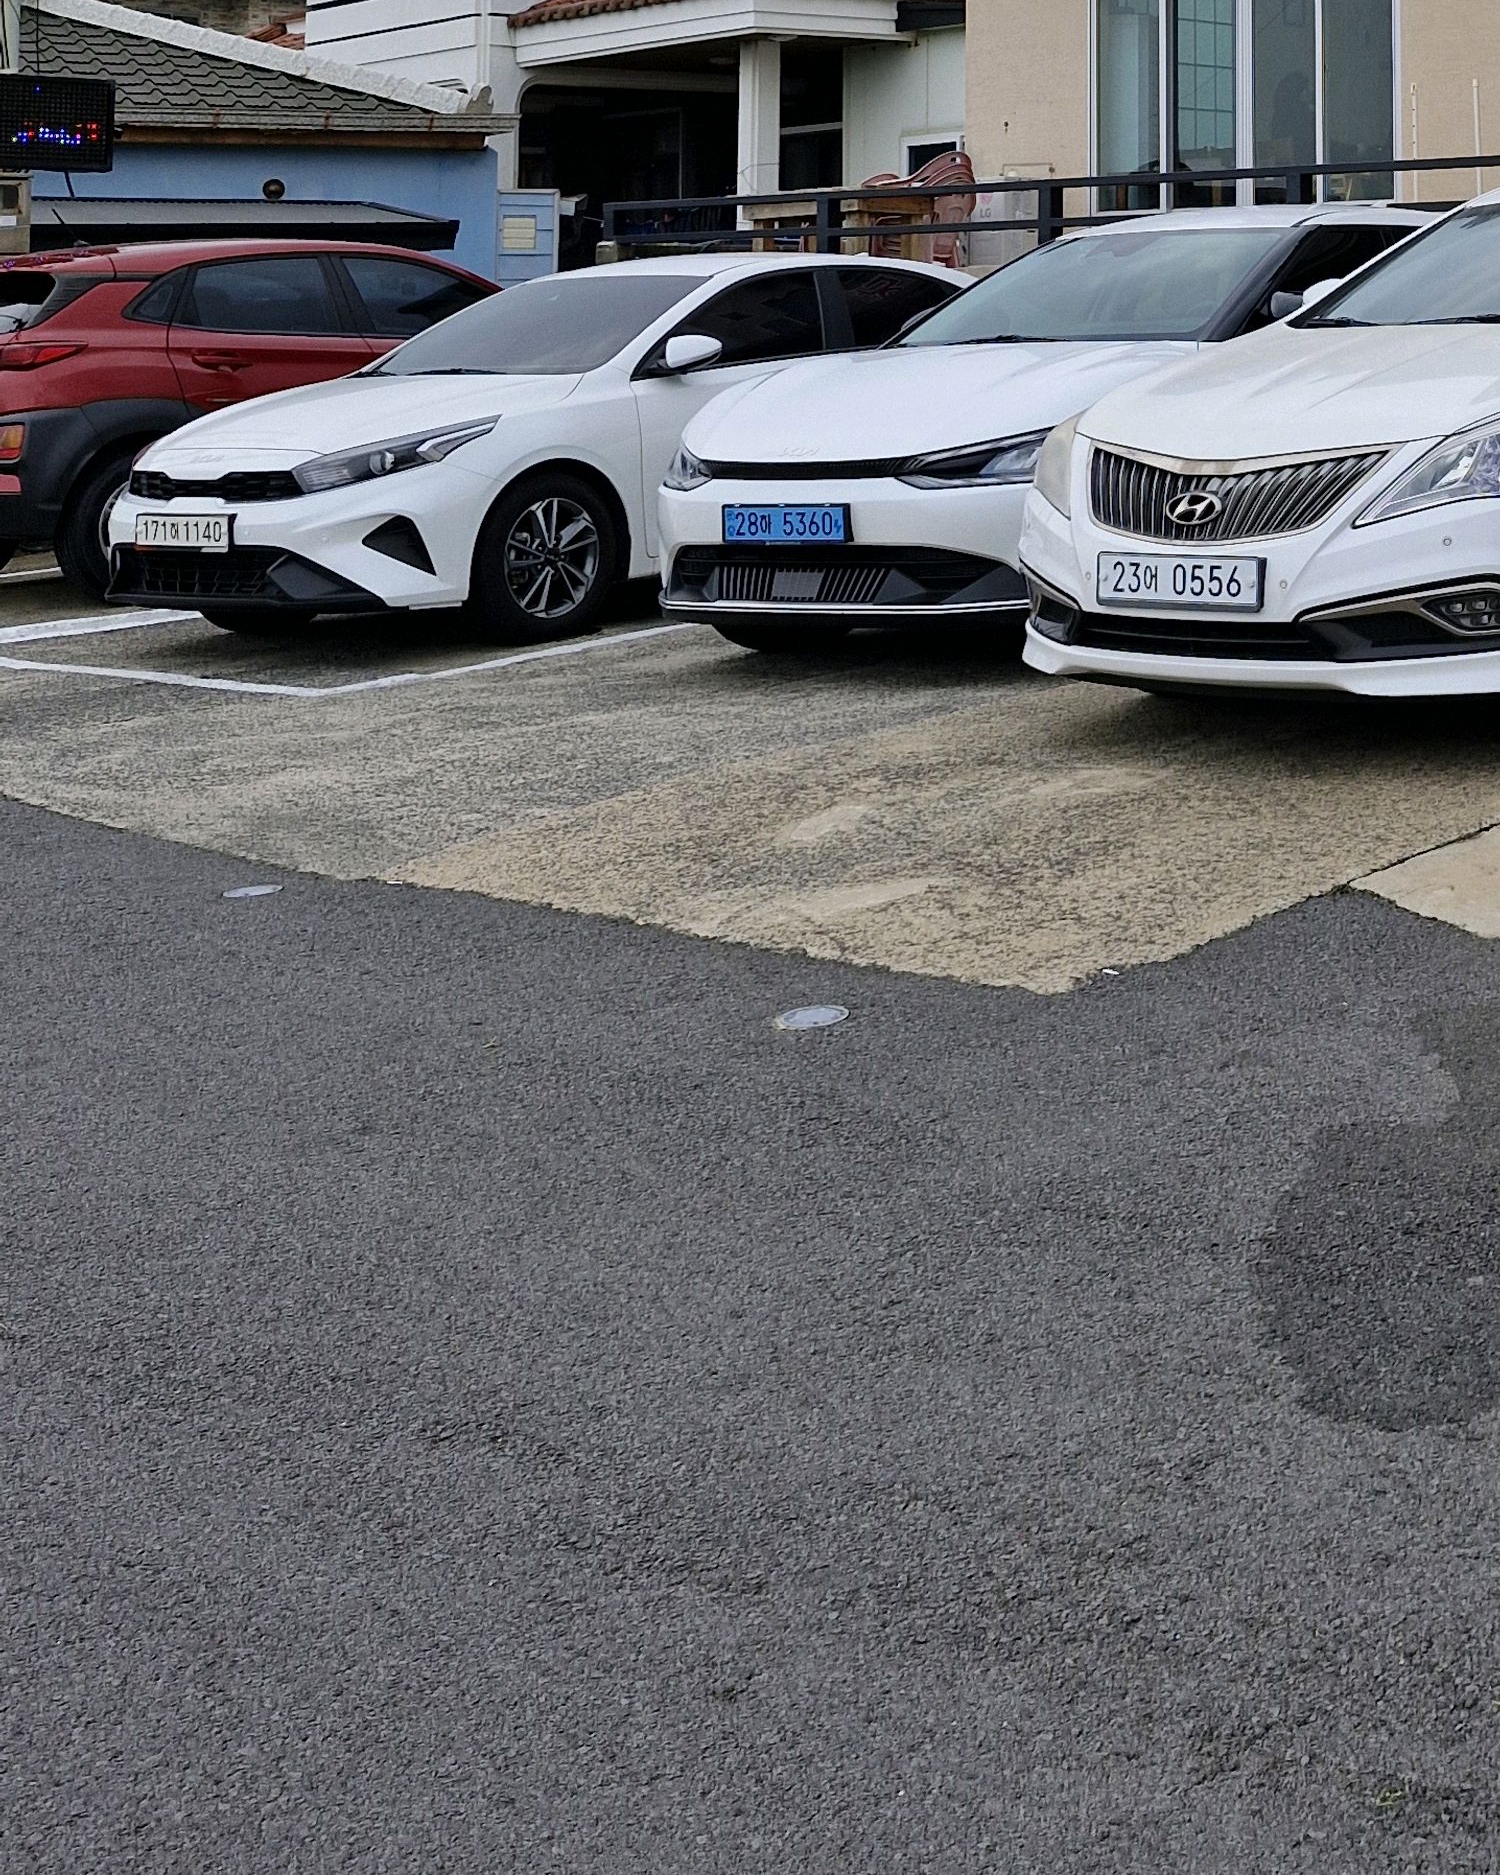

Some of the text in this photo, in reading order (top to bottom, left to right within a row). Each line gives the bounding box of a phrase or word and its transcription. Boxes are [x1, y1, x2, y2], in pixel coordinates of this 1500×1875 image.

[980, 208, 991, 218] LG
[782, 511, 833, 536] 5360
[1172, 563, 1241, 597] 0556
